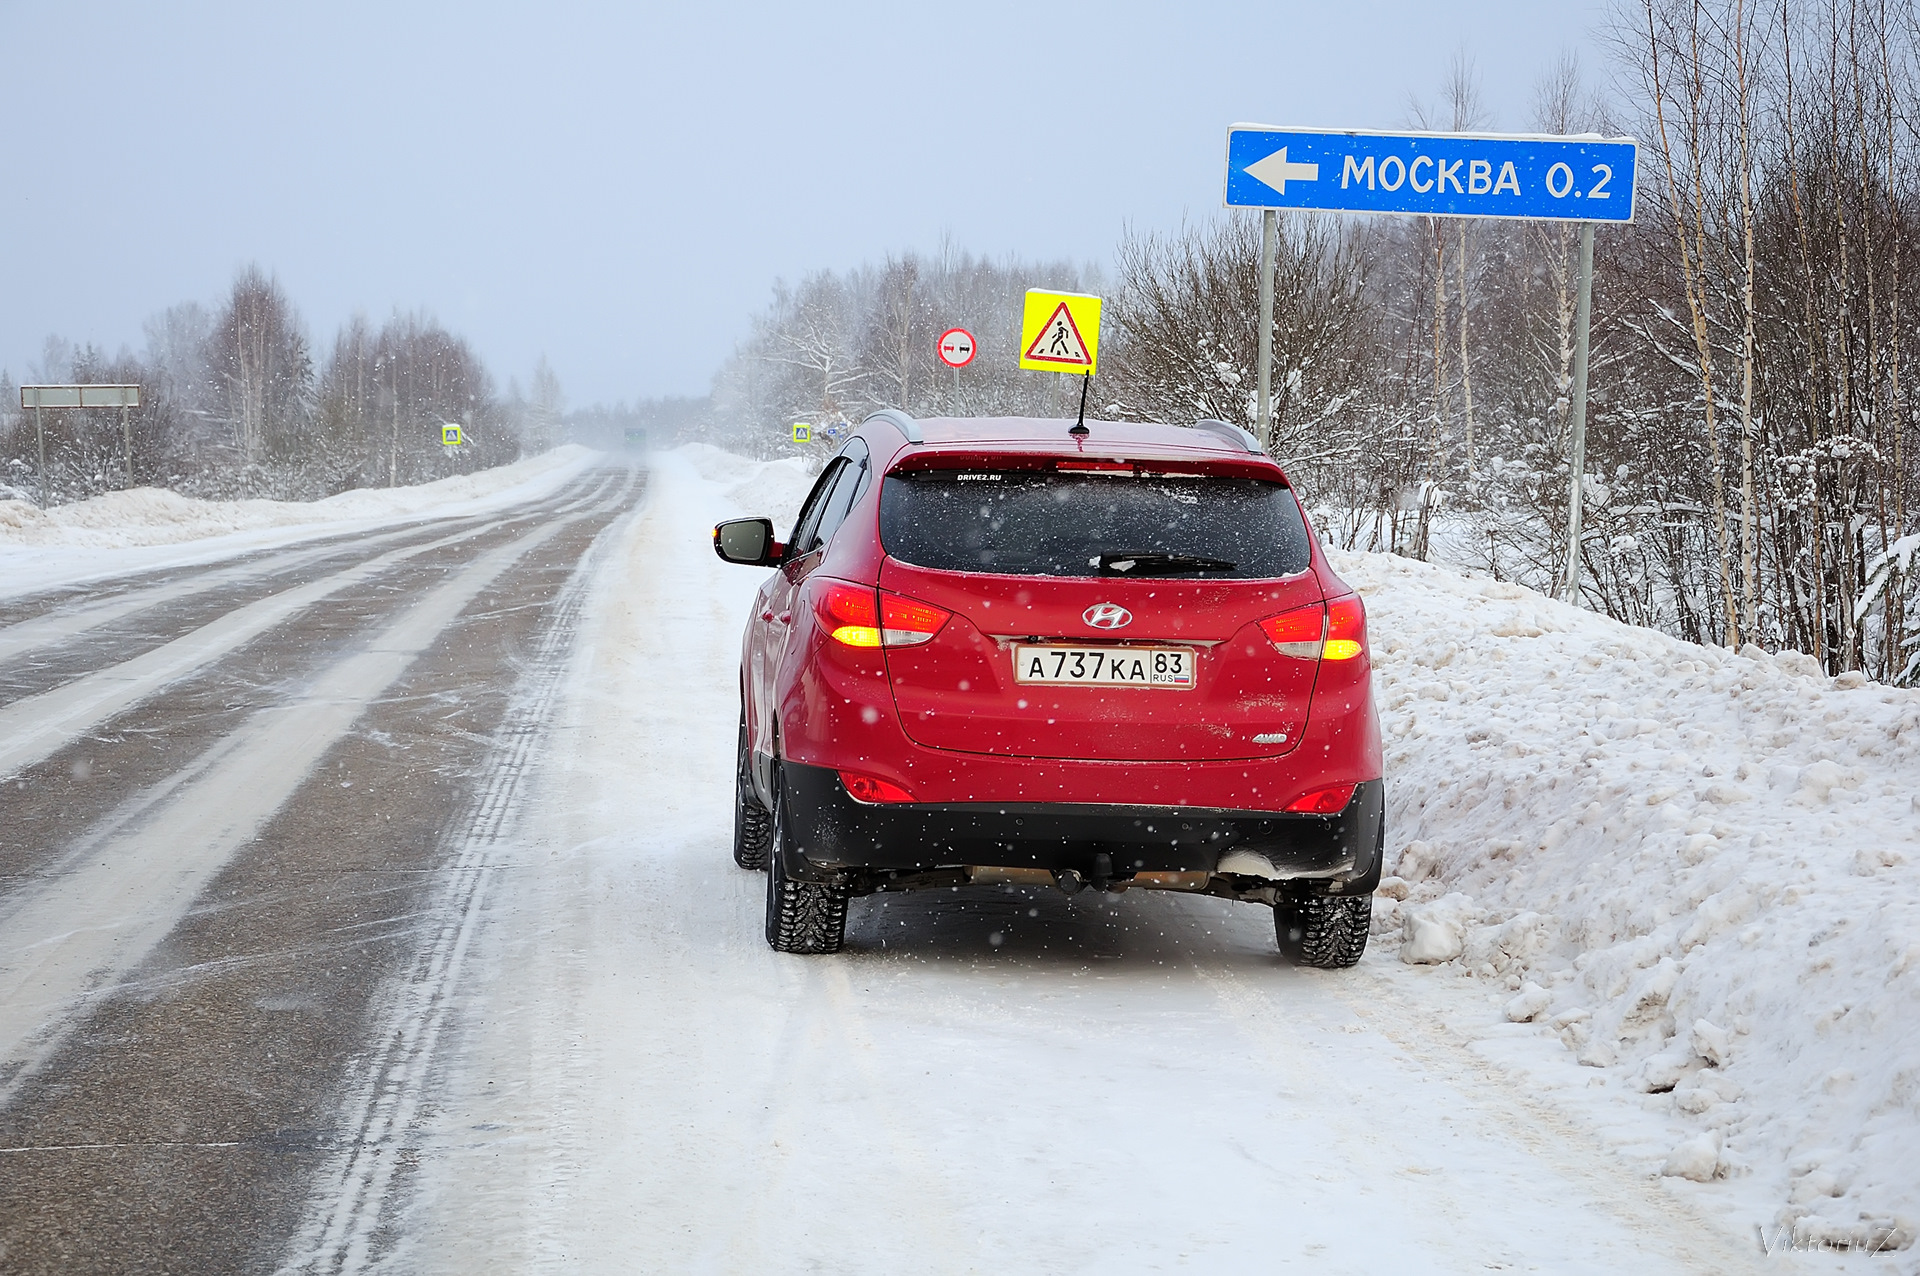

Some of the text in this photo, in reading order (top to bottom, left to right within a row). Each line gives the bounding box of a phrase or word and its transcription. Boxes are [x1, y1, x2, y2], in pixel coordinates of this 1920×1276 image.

[1340, 155, 1613, 199] МОСКВА 0.2
[1154, 653, 1182, 674] 83
[1152, 674, 1174, 682] RUS
